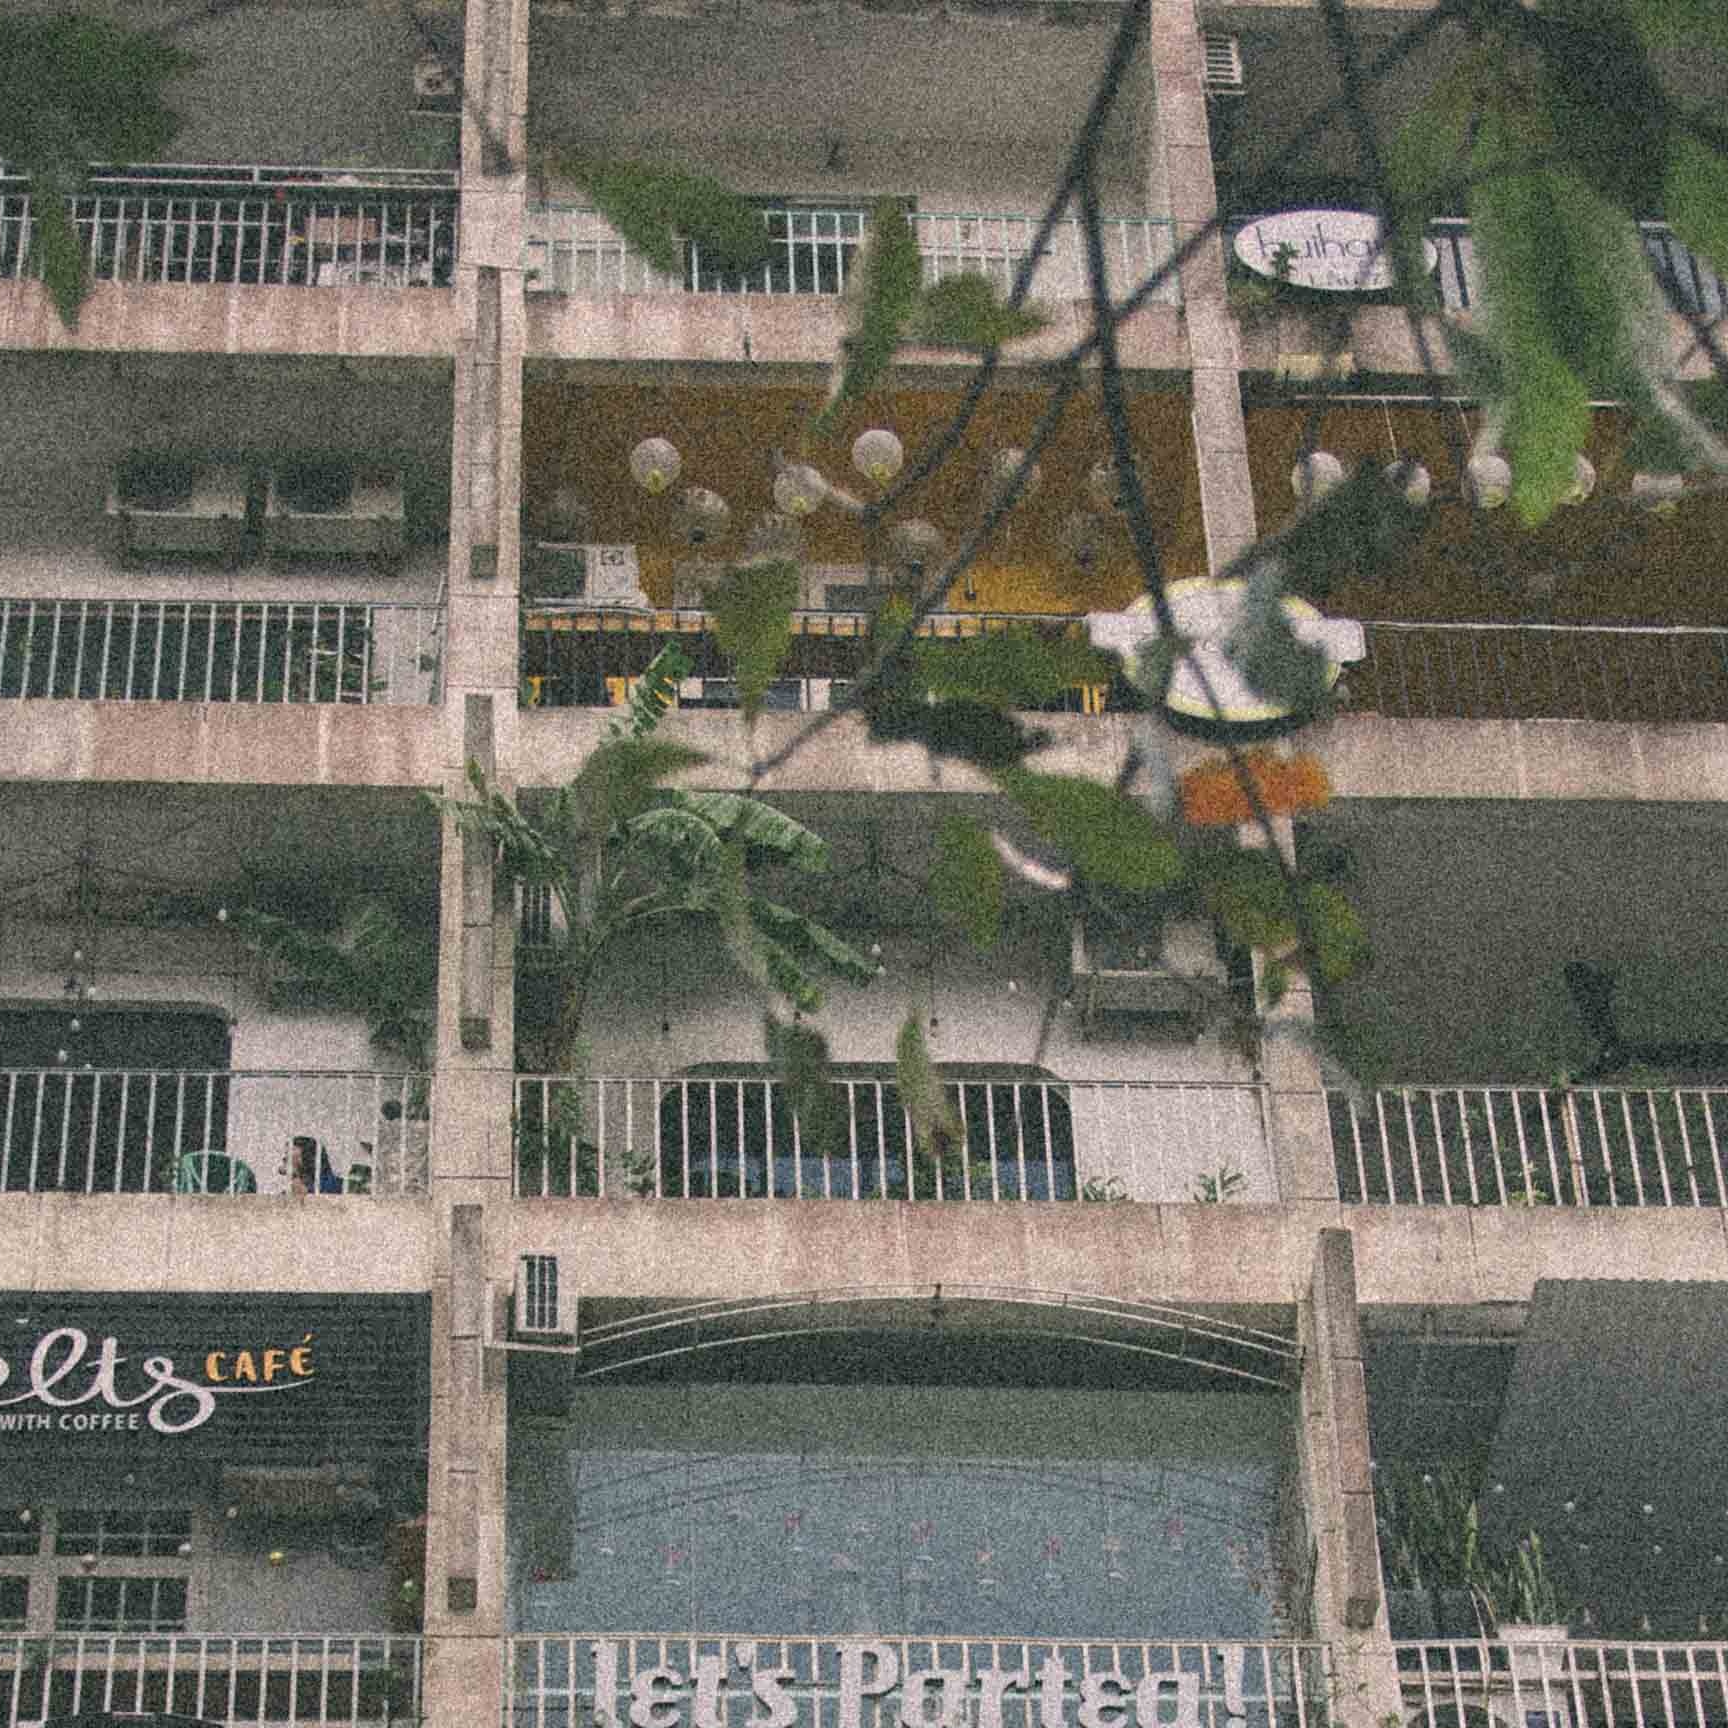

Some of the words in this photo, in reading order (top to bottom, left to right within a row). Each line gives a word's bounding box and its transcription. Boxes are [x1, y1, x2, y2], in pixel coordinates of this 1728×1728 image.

[204, 1333, 317, 1384] CAFÉ
[0, 1412, 51, 1432] WITH
[58, 1412, 140, 1433] COFFEE
